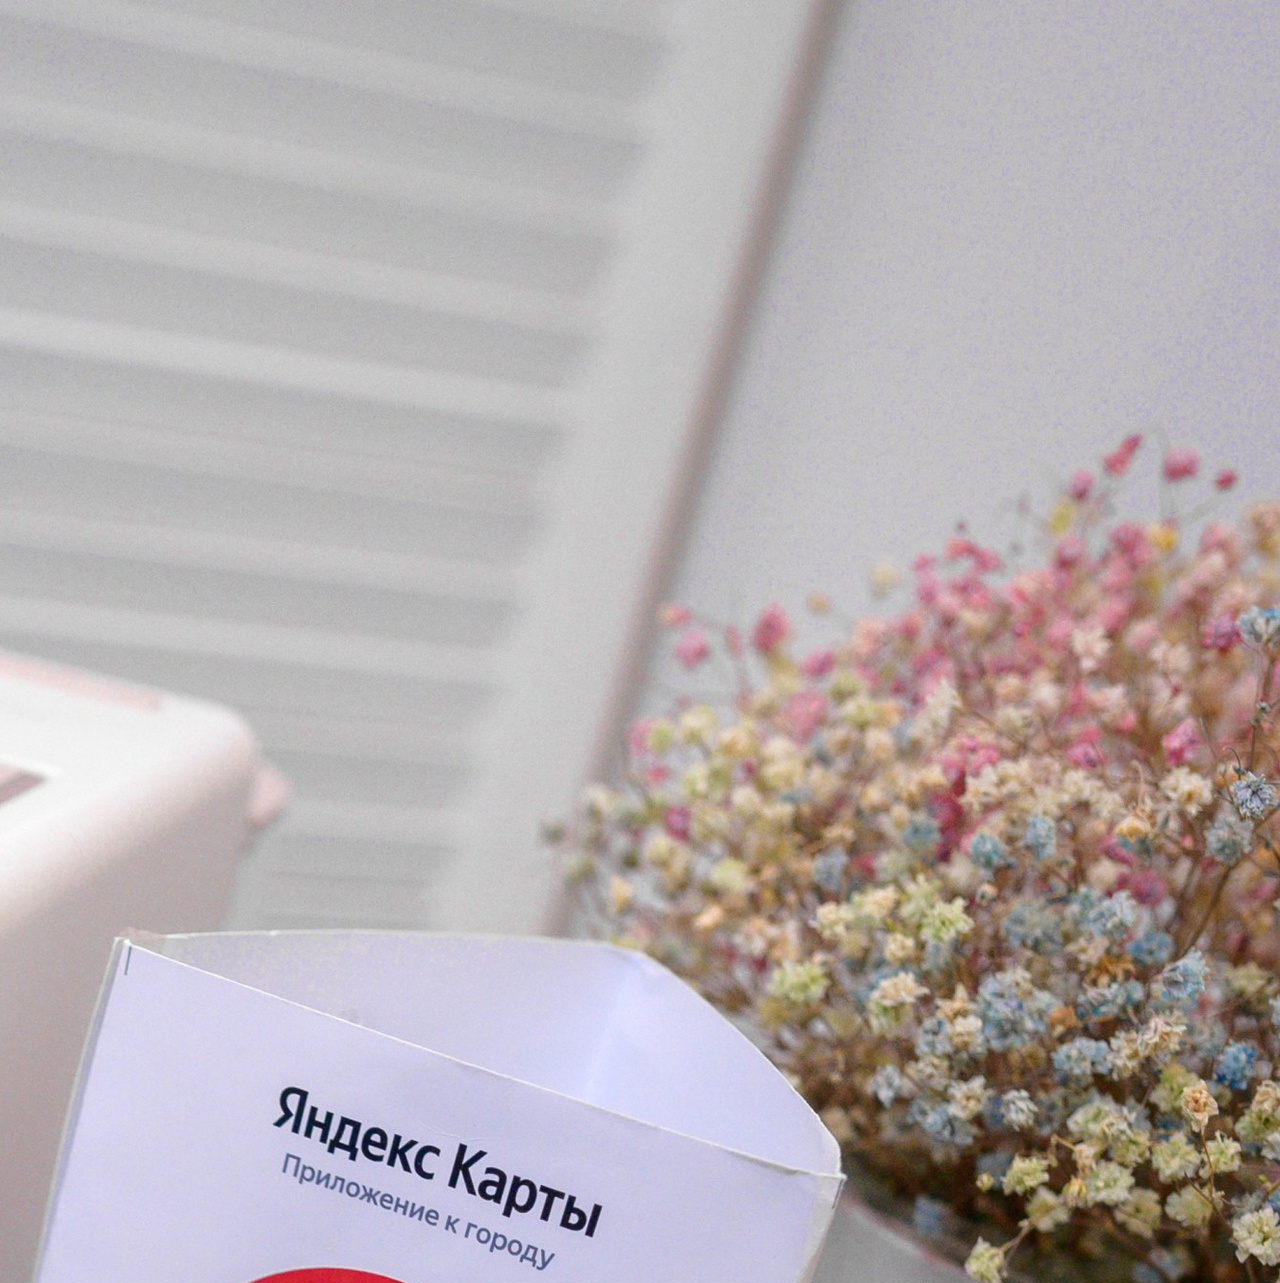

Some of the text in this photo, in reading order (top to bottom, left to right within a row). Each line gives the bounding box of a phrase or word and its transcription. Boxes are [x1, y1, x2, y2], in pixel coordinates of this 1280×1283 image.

[273, 1086, 602, 1238] Яндекс Карты
[282, 1153, 555, 1271] Приложение к городу
